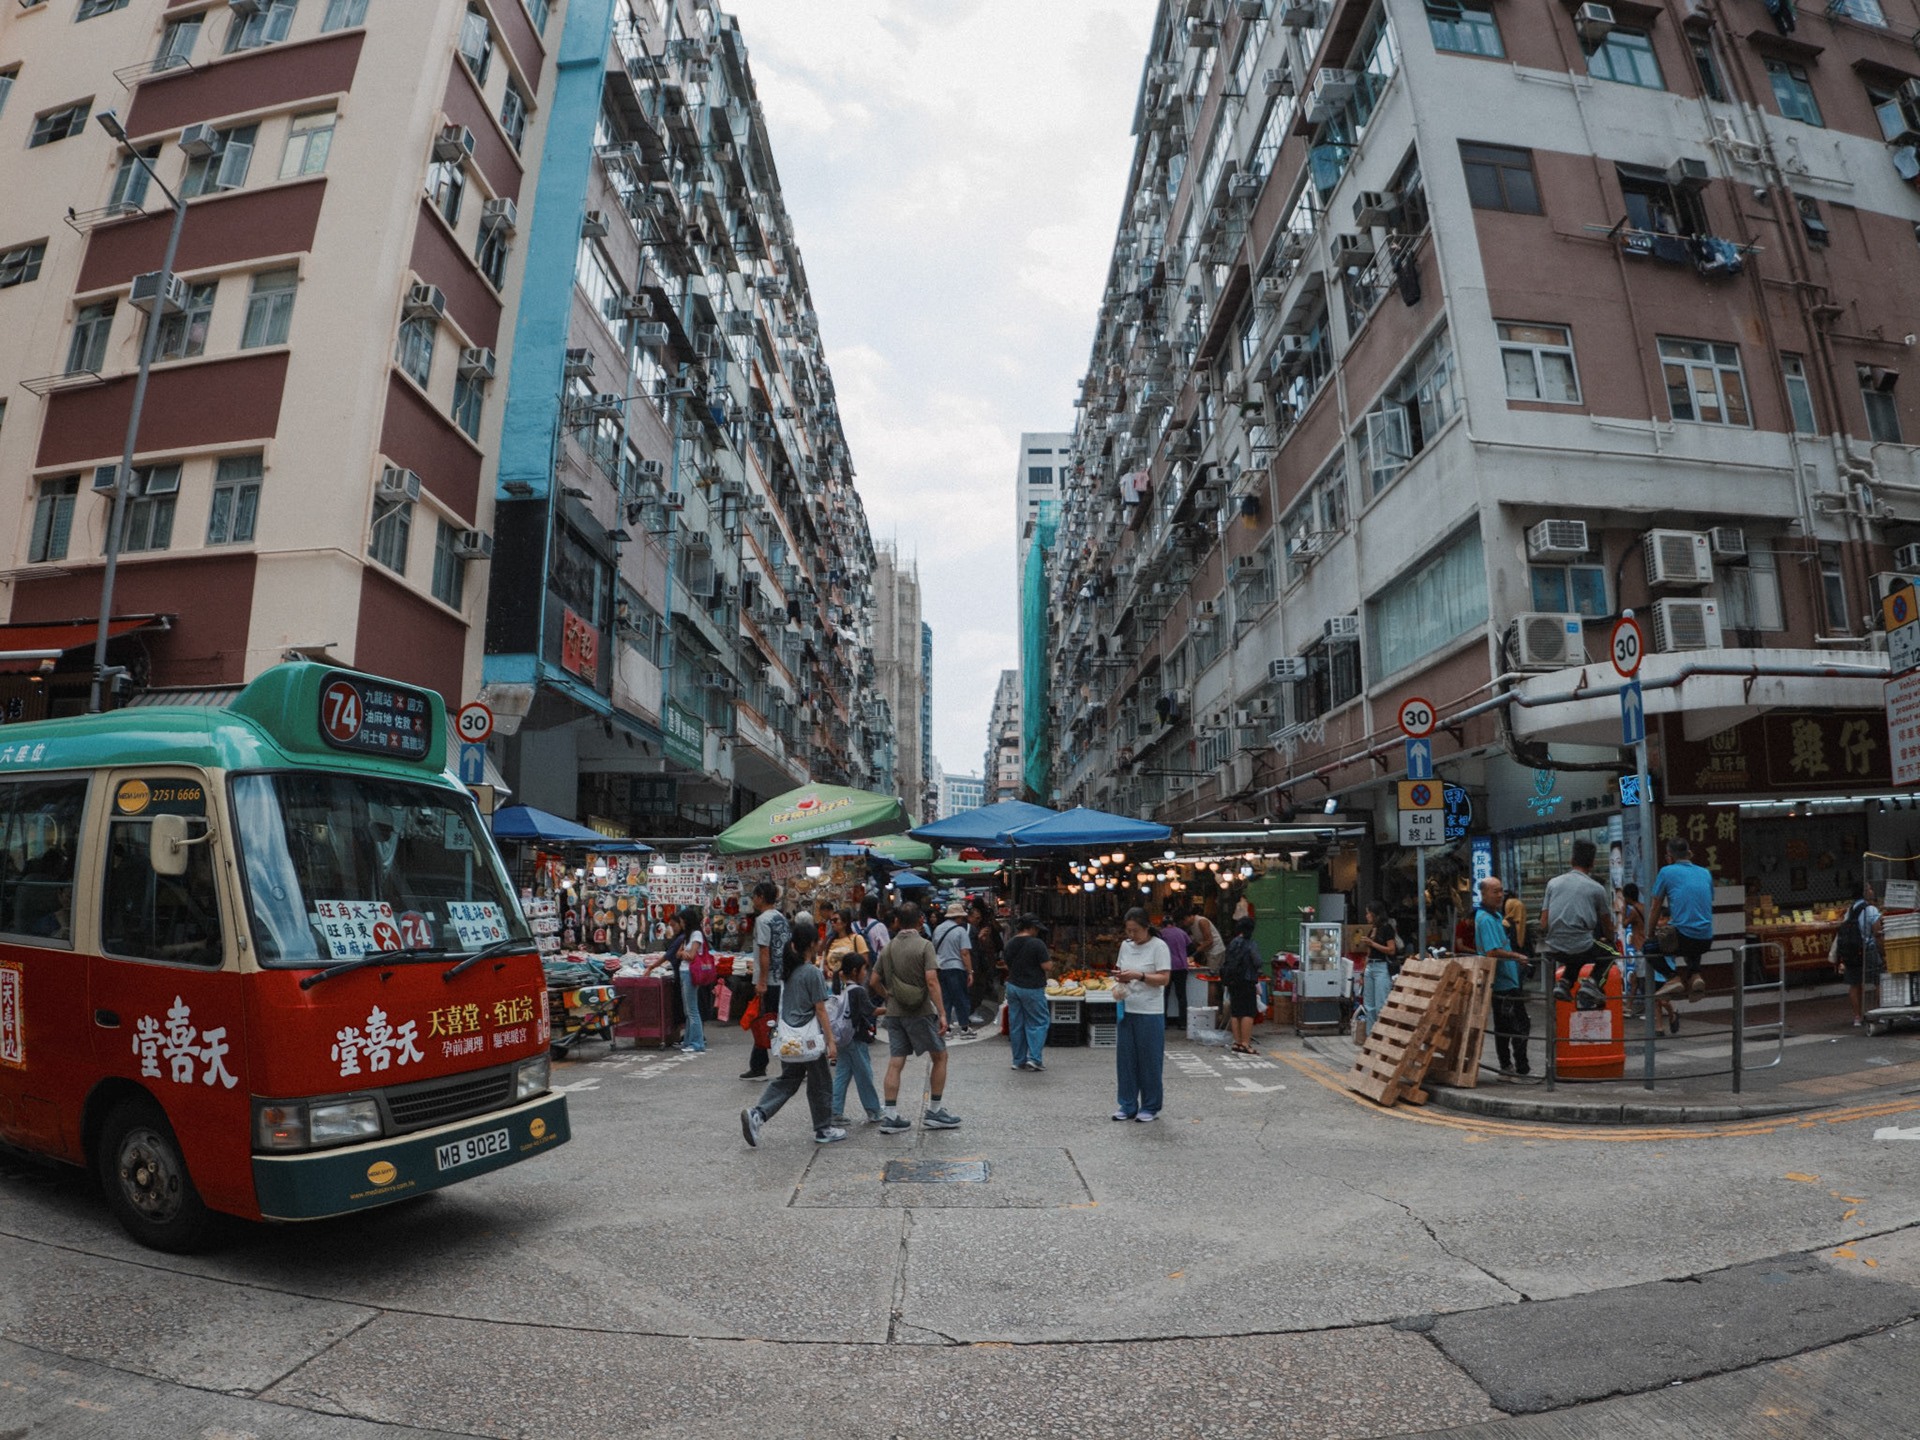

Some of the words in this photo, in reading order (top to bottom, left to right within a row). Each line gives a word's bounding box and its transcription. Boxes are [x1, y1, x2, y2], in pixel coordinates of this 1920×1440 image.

[1907, 625, 1914, 640] 7
[1615, 634, 1637, 662] 30
[365, 689, 392, 708] 九龍站
[329, 692, 357, 733] 74
[364, 708, 392, 727] 油麻地
[1404, 710, 1430, 727] 30
[462, 715, 487, 730] 30
[360, 729, 388, 747] 柯士甸
[0, 743, 46, 763] 六座位
[152, 789, 175, 802] 2751
[177, 787, 200, 801] 6666
[1412, 814, 1433, 824] End
[1408, 827, 1437, 842] 終止
[319, 902, 380, 920] 旺角太子
[450, 904, 485, 921] 九龍站
[326, 922, 372, 939] 旺角東
[400, 919, 432, 947] 74
[333, 941, 373, 958] 油麻地
[441, 1035, 484, 1059] 孕前調理
[438, 1147, 460, 1169] MB
[467, 1131, 508, 1160] 9022
